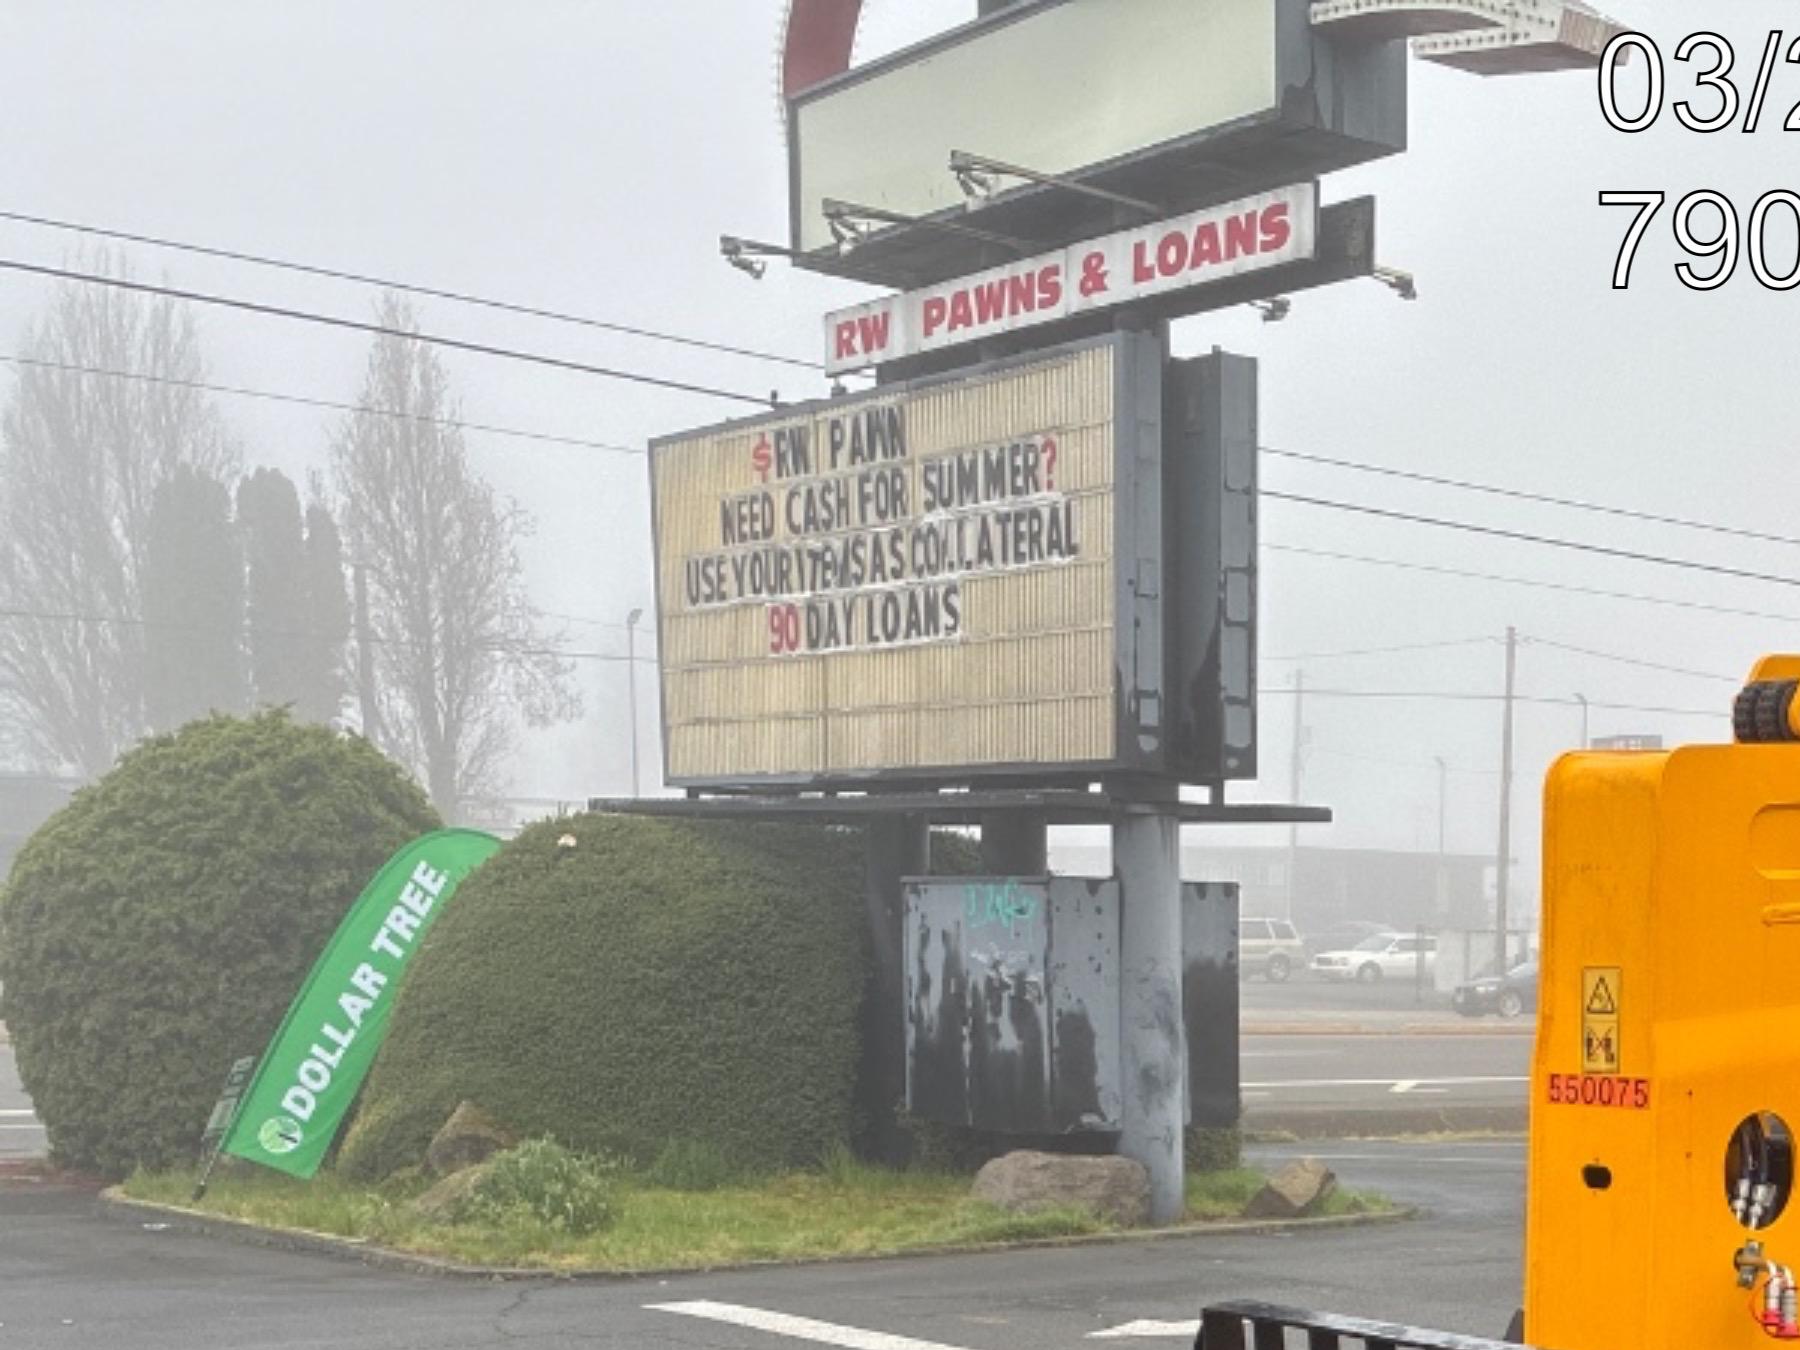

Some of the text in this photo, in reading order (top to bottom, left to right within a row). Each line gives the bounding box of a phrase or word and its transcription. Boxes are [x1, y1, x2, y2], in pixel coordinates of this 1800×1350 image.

[834, 202, 1292, 360] RW PAWNS & LOANS
[830, 405, 906, 469] PAWN
[721, 438, 1057, 546] NEED CASH FOR SUMMER?
[687, 554, 727, 607] USE
[732, 549, 793, 597] YOUR
[870, 528, 905, 584] AS
[769, 581, 960, 654] 90 DAY LOANS
[280, 859, 449, 1123] DOLLAR TREE
[1549, 1072, 1650, 1109] 550075
